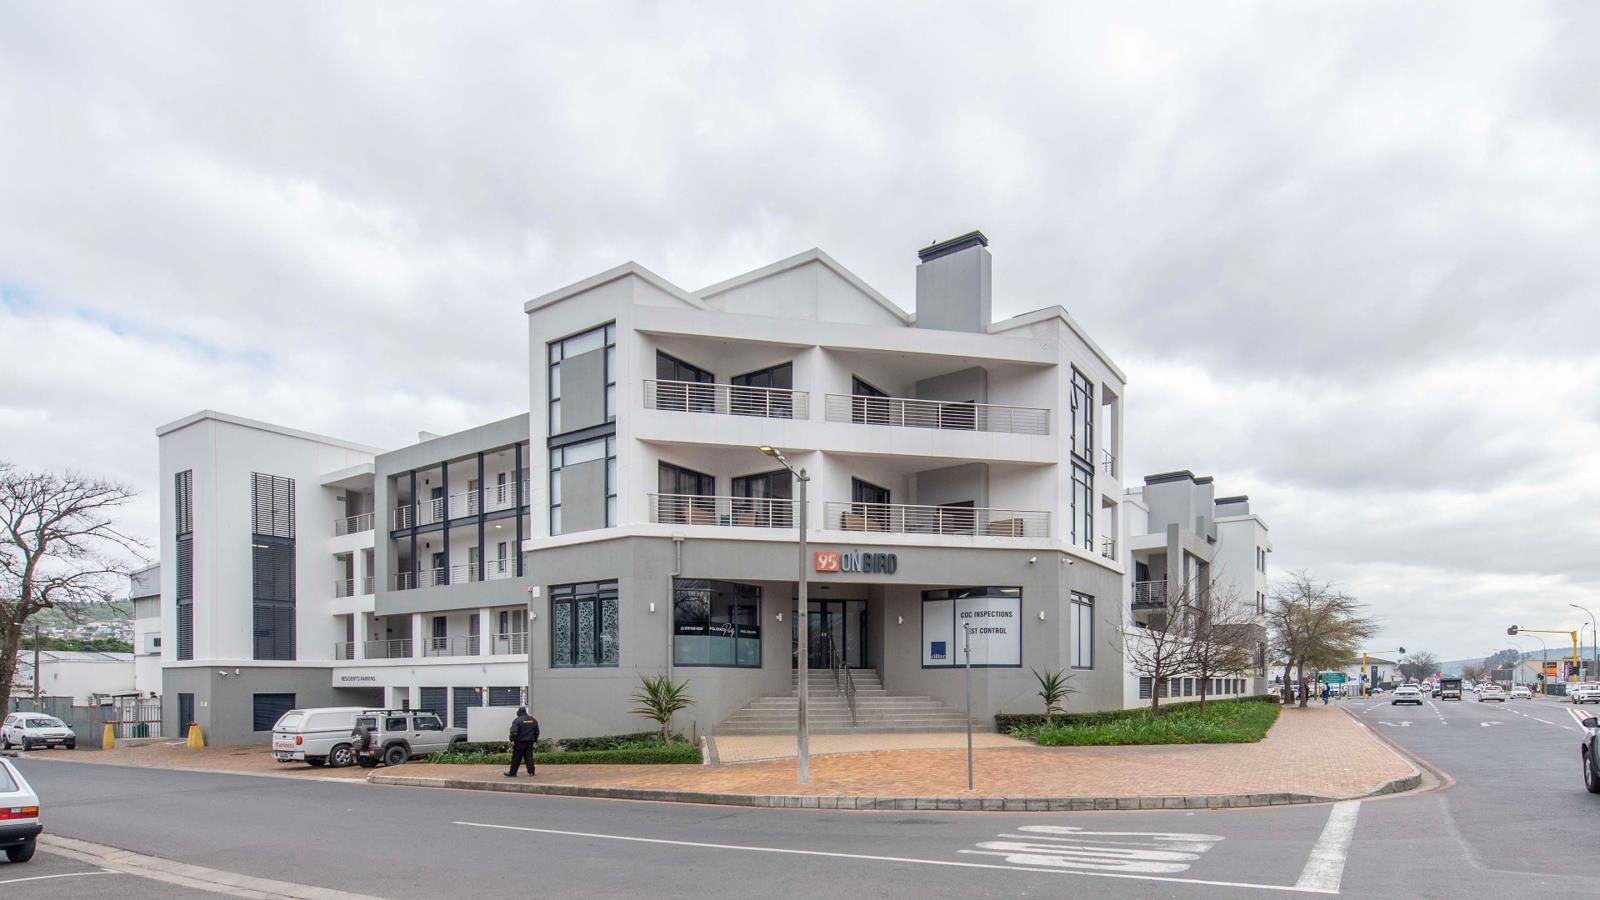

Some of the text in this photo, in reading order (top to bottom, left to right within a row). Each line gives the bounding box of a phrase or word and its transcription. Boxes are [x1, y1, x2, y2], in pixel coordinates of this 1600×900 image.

[818, 551, 898, 574] 95 ON BIRD
[974, 610, 1013, 618] INSPECTIONS
[979, 627, 1007, 635] CONTROL
